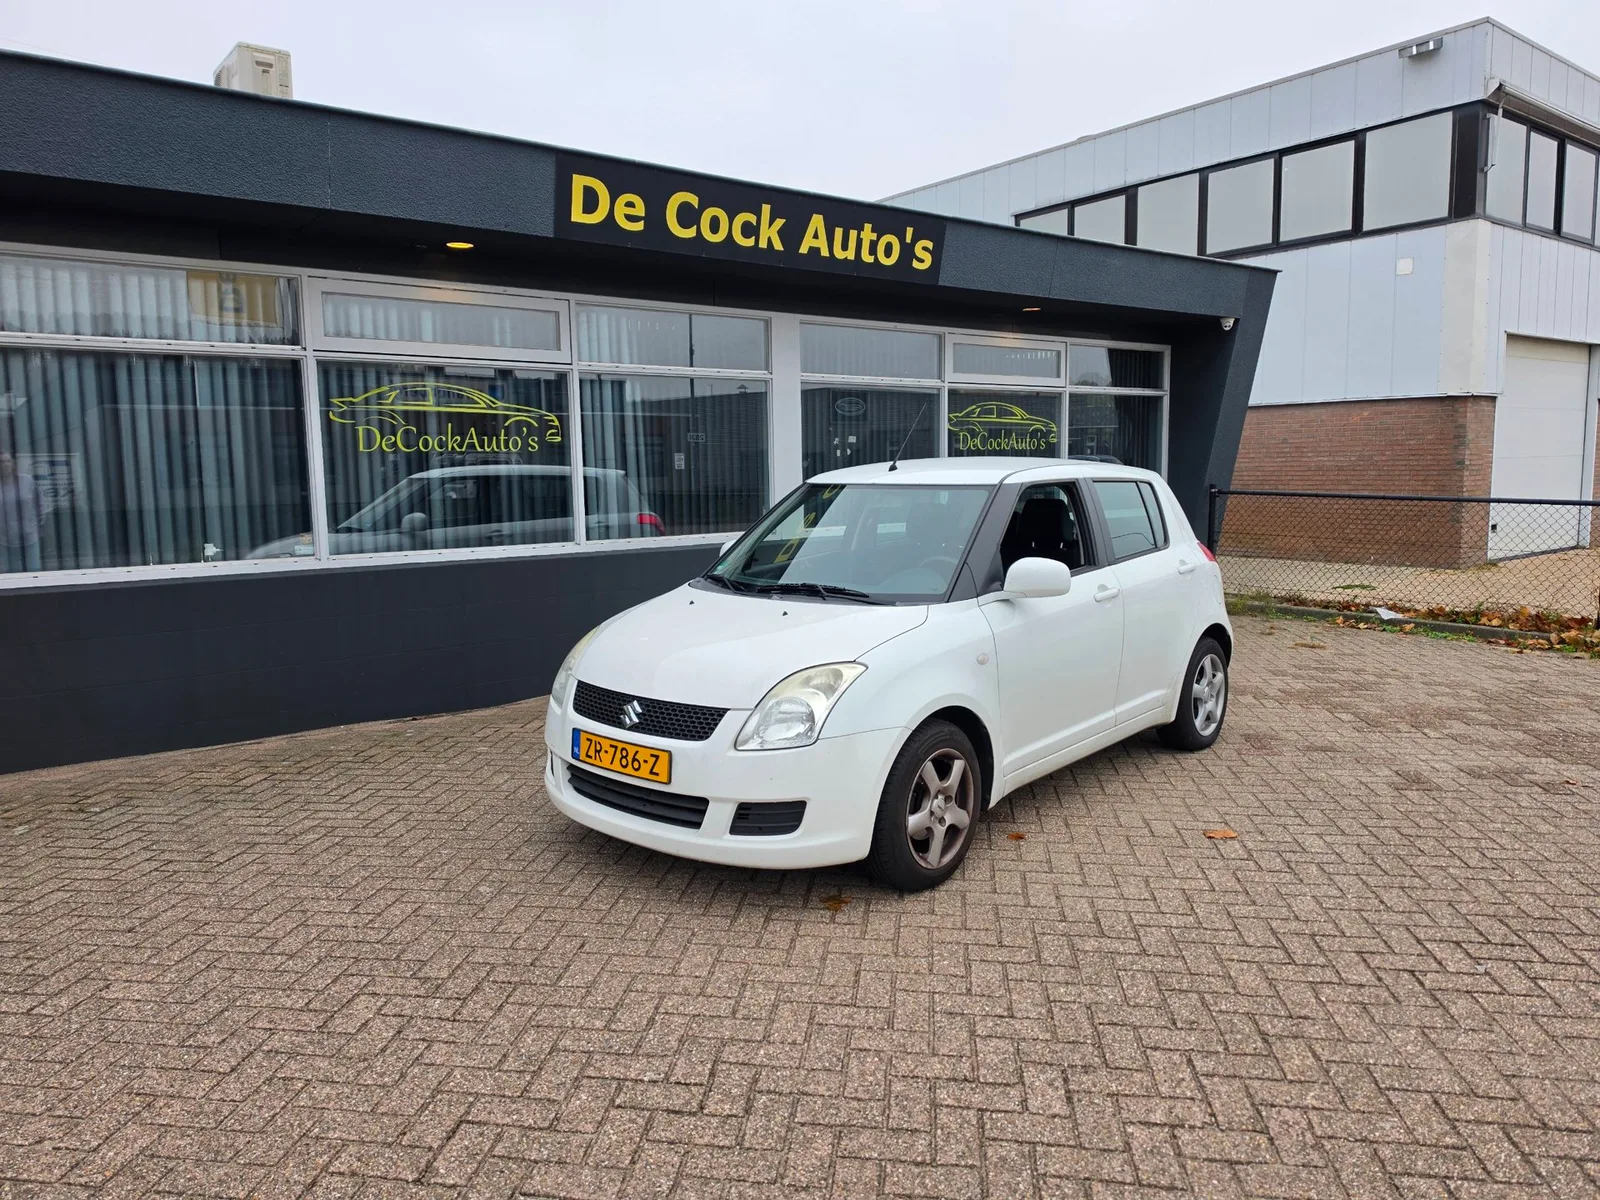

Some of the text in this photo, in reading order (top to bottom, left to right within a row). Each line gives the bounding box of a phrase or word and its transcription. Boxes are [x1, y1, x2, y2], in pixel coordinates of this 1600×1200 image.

[570, 173, 934, 270] De Cock Auto's
[585, 738, 660, 777] ZR-786-Z
